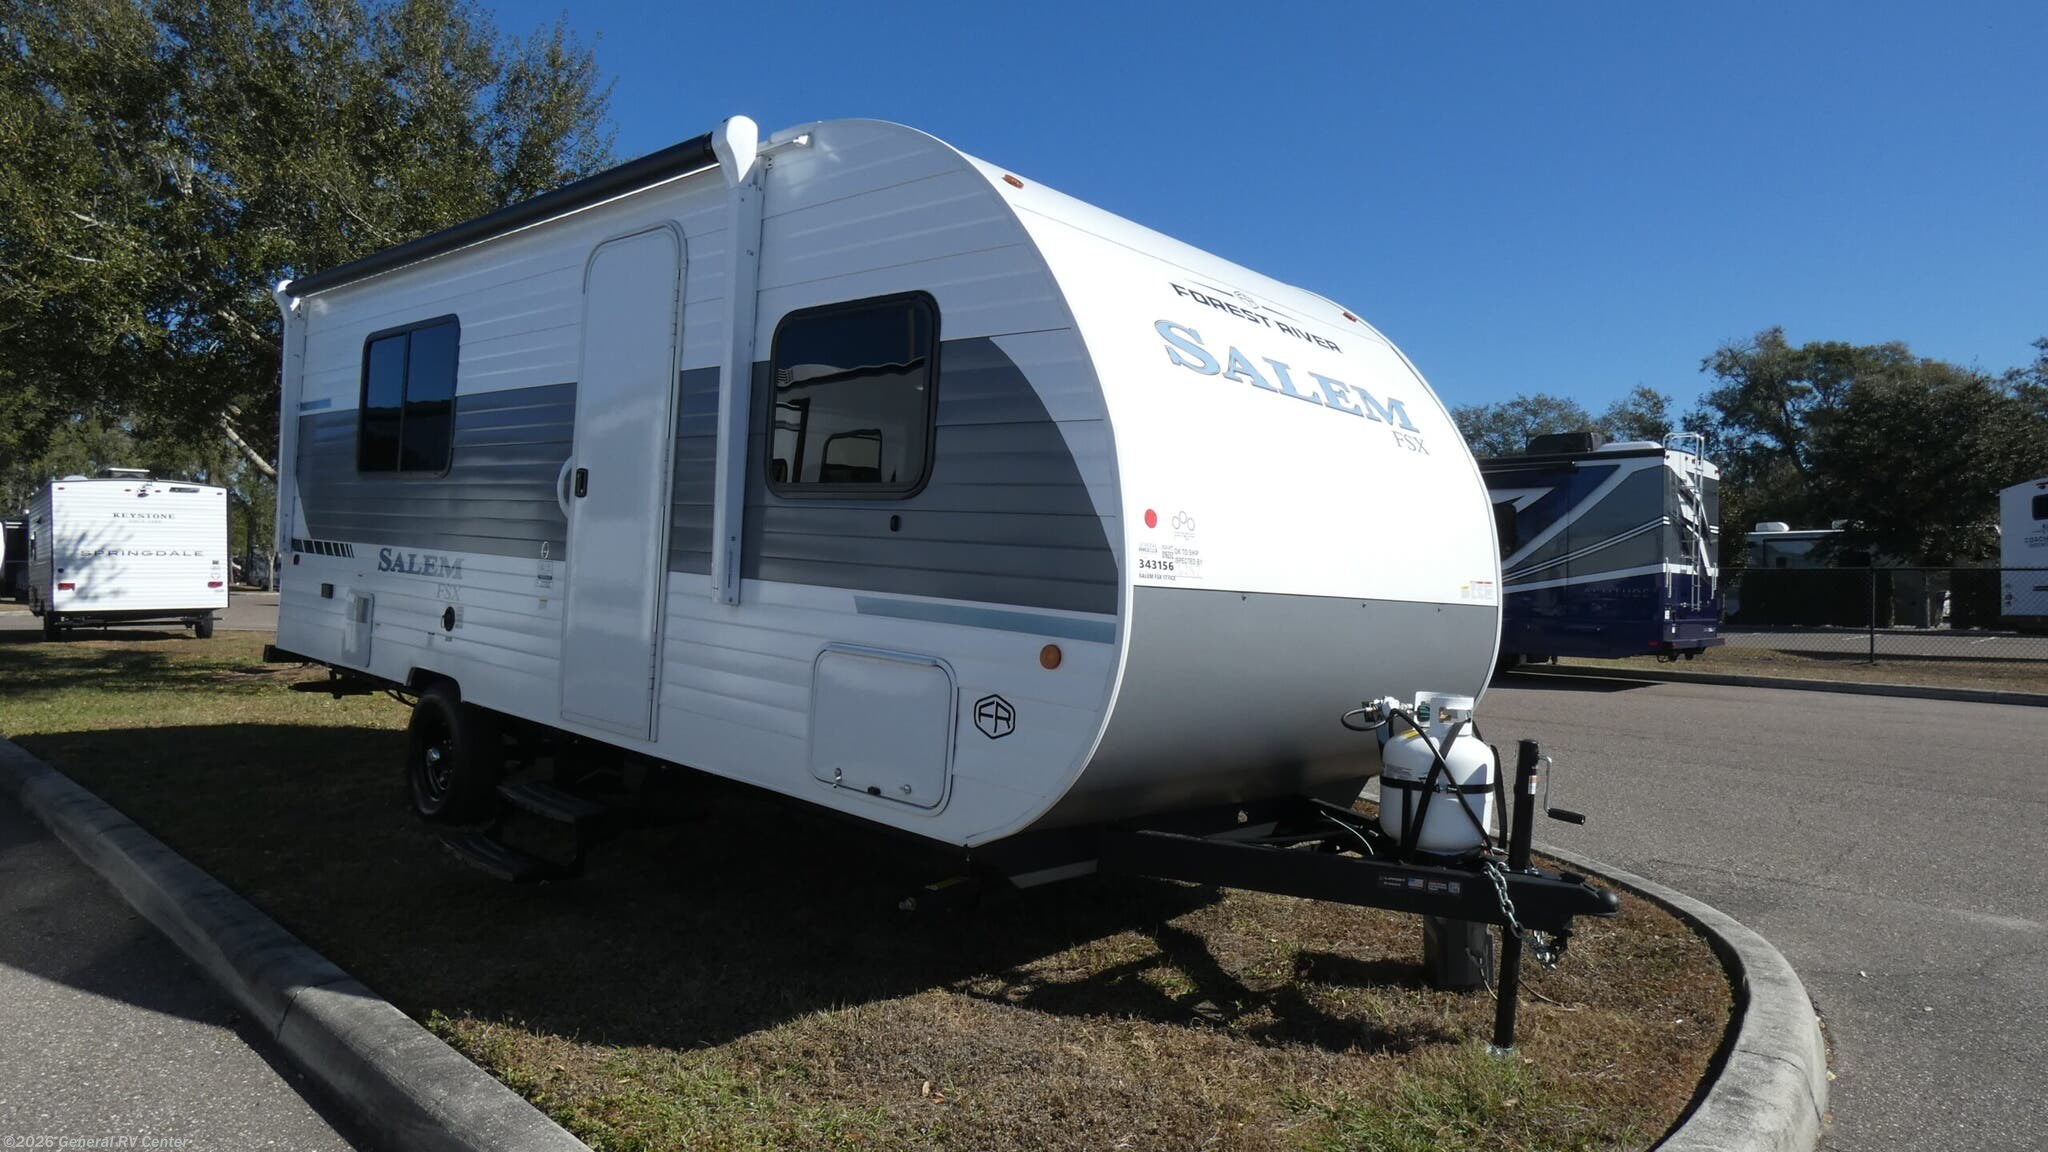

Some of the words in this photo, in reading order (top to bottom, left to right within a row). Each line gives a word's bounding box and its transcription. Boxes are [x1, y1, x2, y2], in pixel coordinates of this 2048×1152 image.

[1169, 282, 1271, 328] FOREST
[1274, 320, 1344, 354] RIVER
[1154, 320, 1420, 433] SALEM
[1392, 430, 1431, 456] FSX
[112, 511, 176, 520] KEYSTONE
[378, 547, 464, 579] SALEM
[1139, 559, 1174, 571] 343156
[437, 582, 462, 601] FSX
